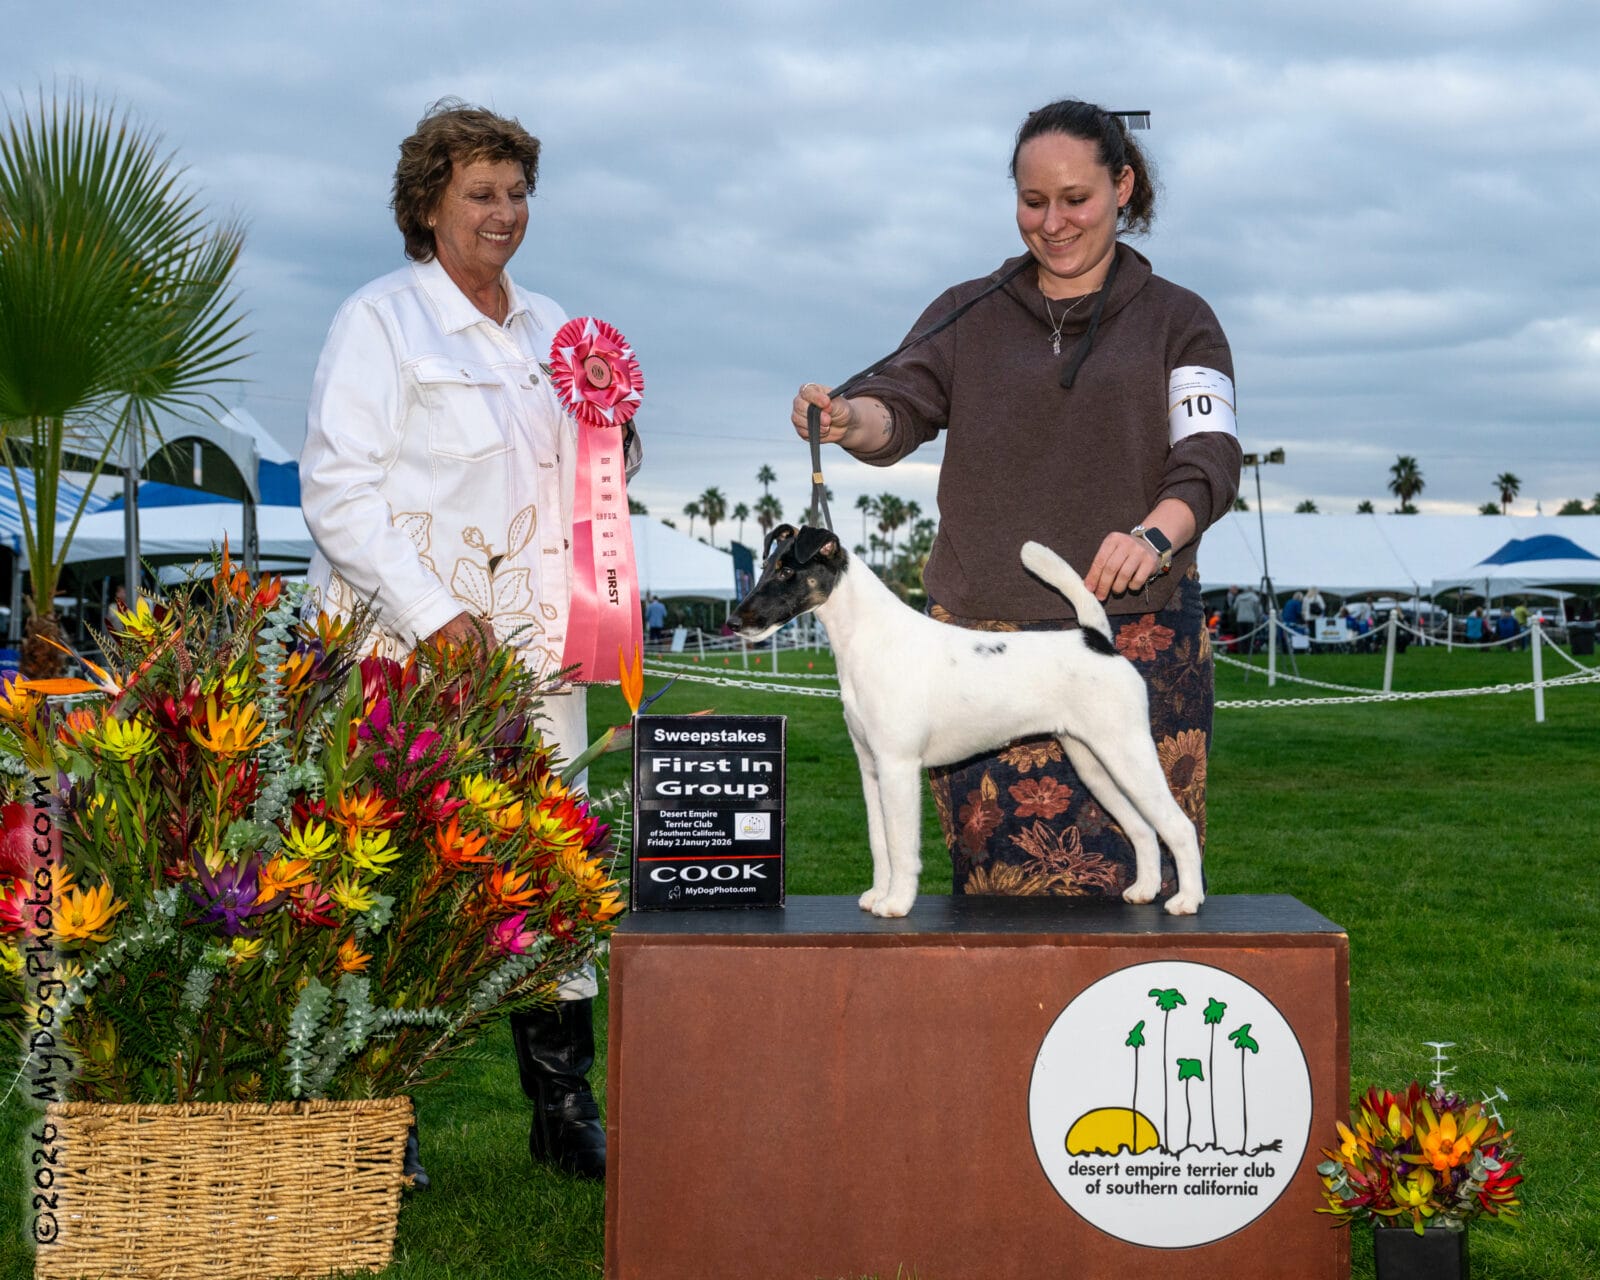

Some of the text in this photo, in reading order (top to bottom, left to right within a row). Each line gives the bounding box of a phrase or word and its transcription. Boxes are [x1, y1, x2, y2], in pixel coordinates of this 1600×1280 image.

[1182, 394, 1212, 417] 10
[607, 568, 619, 605] FIRST
[654, 728, 767, 745] Sweepstakes
[652, 757, 773, 773] First In
[655, 780, 769, 799] Group
[693, 820, 713, 828] Club
[648, 839, 673, 847] Friday
[675, 838, 681, 846] 2
[682, 838, 709, 847] Janury
[650, 864, 767, 882] COOK
[685, 885, 757, 896] MyDogPhoto.com
[1068, 1160, 1276, 1180] desert empire terrier club
[1085, 1179, 1259, 1196] of southern california
